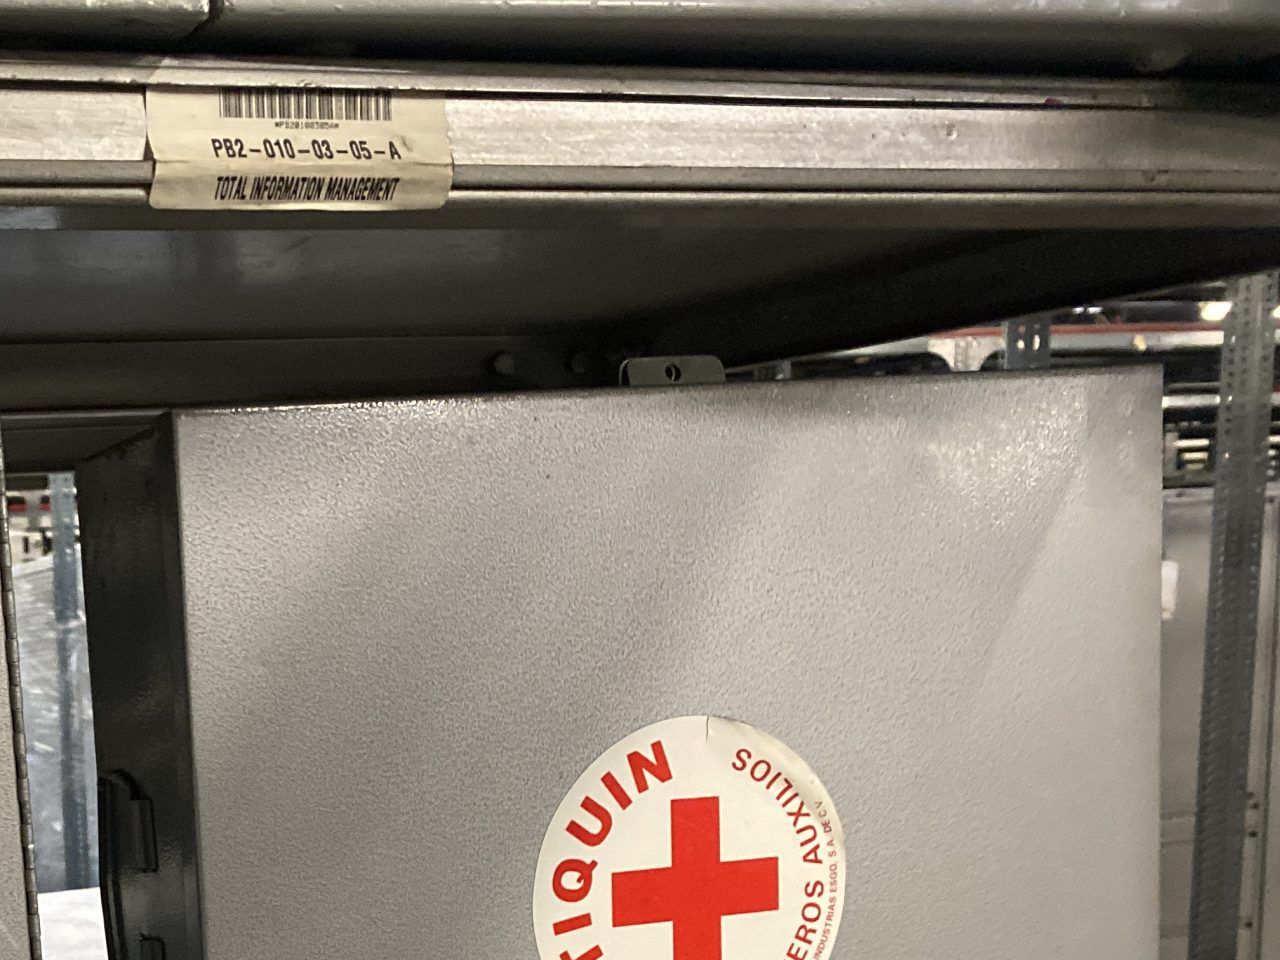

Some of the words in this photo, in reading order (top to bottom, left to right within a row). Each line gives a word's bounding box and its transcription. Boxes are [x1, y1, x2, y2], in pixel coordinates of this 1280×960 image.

[211, 138, 402, 160] PB2-010-03-05-A
[214, 176, 247, 200] TOTAL
[250, 176, 325, 201] INFORMATION
[324, 177, 400, 201] MANAGEMENT
[732, 748, 824, 864] AUXILIOS
[813, 896, 837, 960] INDUSTRIAS
